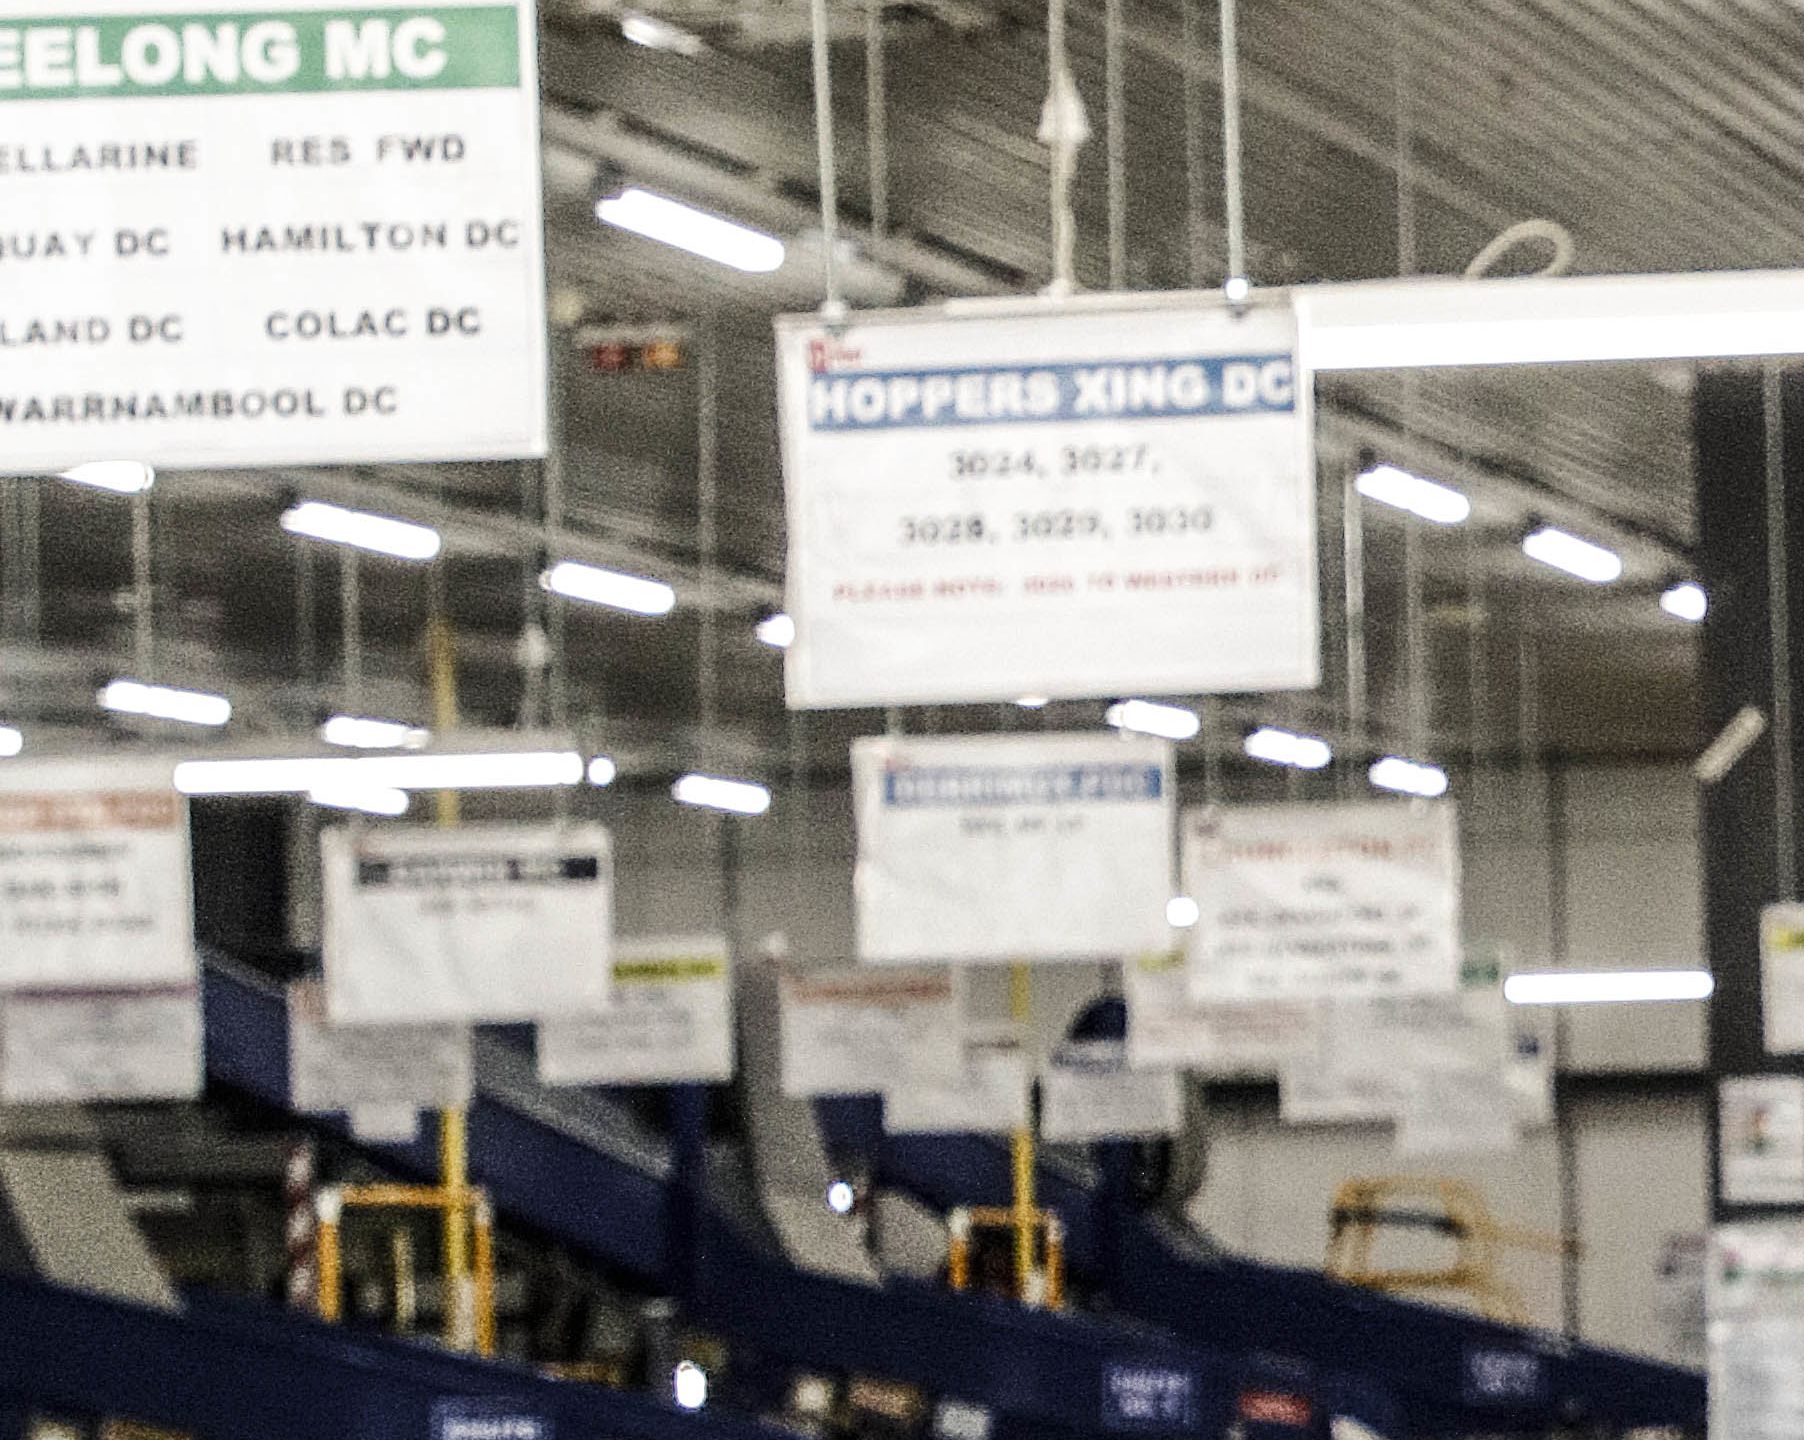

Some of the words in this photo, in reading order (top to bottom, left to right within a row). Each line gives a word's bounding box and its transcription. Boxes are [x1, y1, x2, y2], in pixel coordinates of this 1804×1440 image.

[324, 17, 449, 79] MC
[270, 137, 351, 166] RES
[376, 134, 467, 164] FWD
[0, 229, 94, 260] UAY
[115, 227, 171, 257] DC
[221, 221, 448, 255] HAMILTON
[465, 219, 520, 249] DC
[128, 314, 184, 344] DC
[265, 309, 408, 341] COLAC
[427, 308, 482, 337] DC
[344, 385, 399, 416] DC
[811, 371, 1060, 424] HOPPERS
[1074, 364, 1210, 413] XING
[1222, 360, 1294, 408] DC
